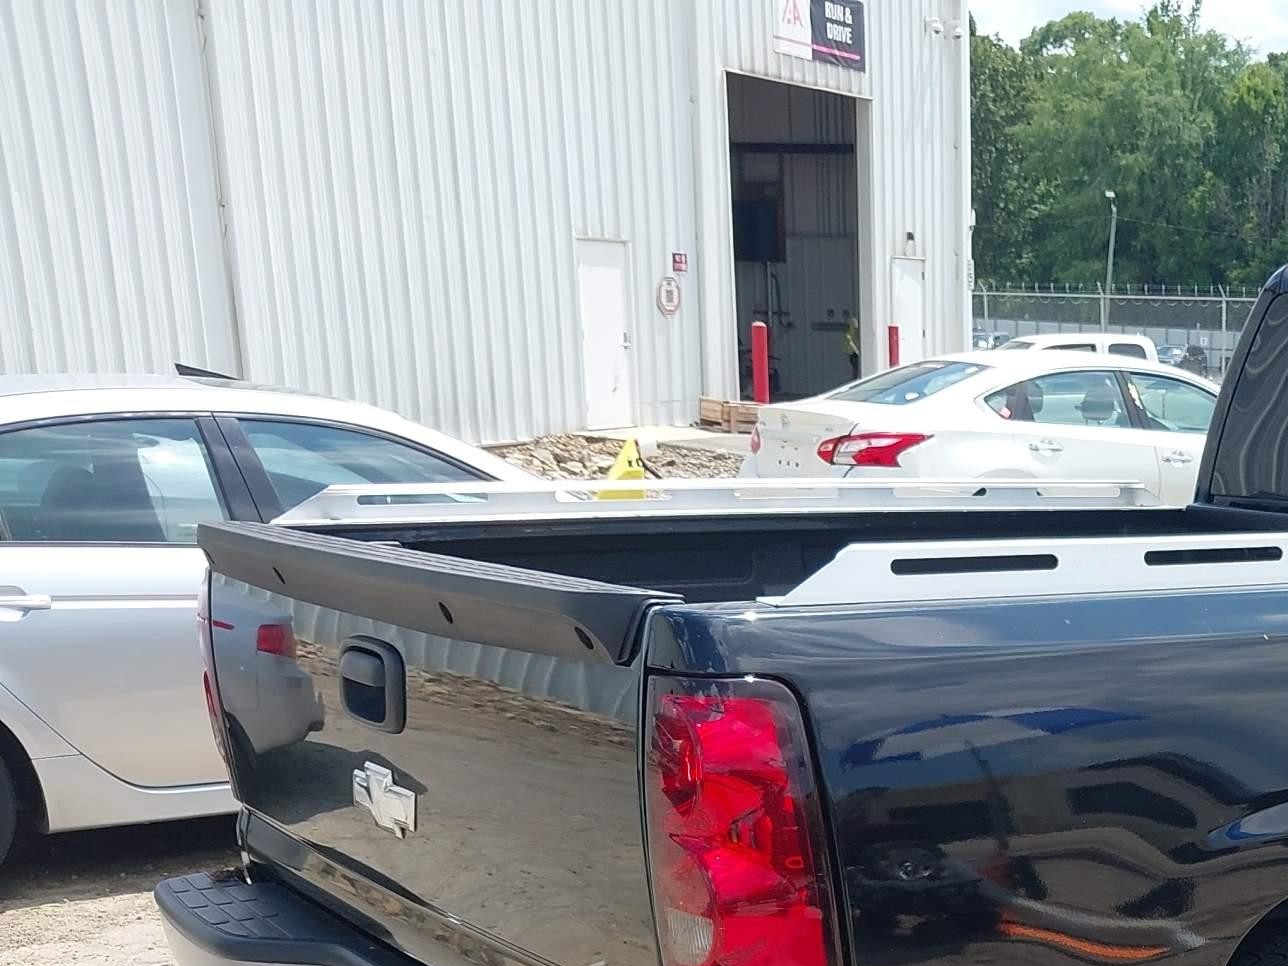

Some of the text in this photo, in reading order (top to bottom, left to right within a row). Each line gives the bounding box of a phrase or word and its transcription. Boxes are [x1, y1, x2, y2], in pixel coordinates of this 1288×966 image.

[825, 1, 853, 25] RUN &
[826, 22, 852, 44] DRIVE
